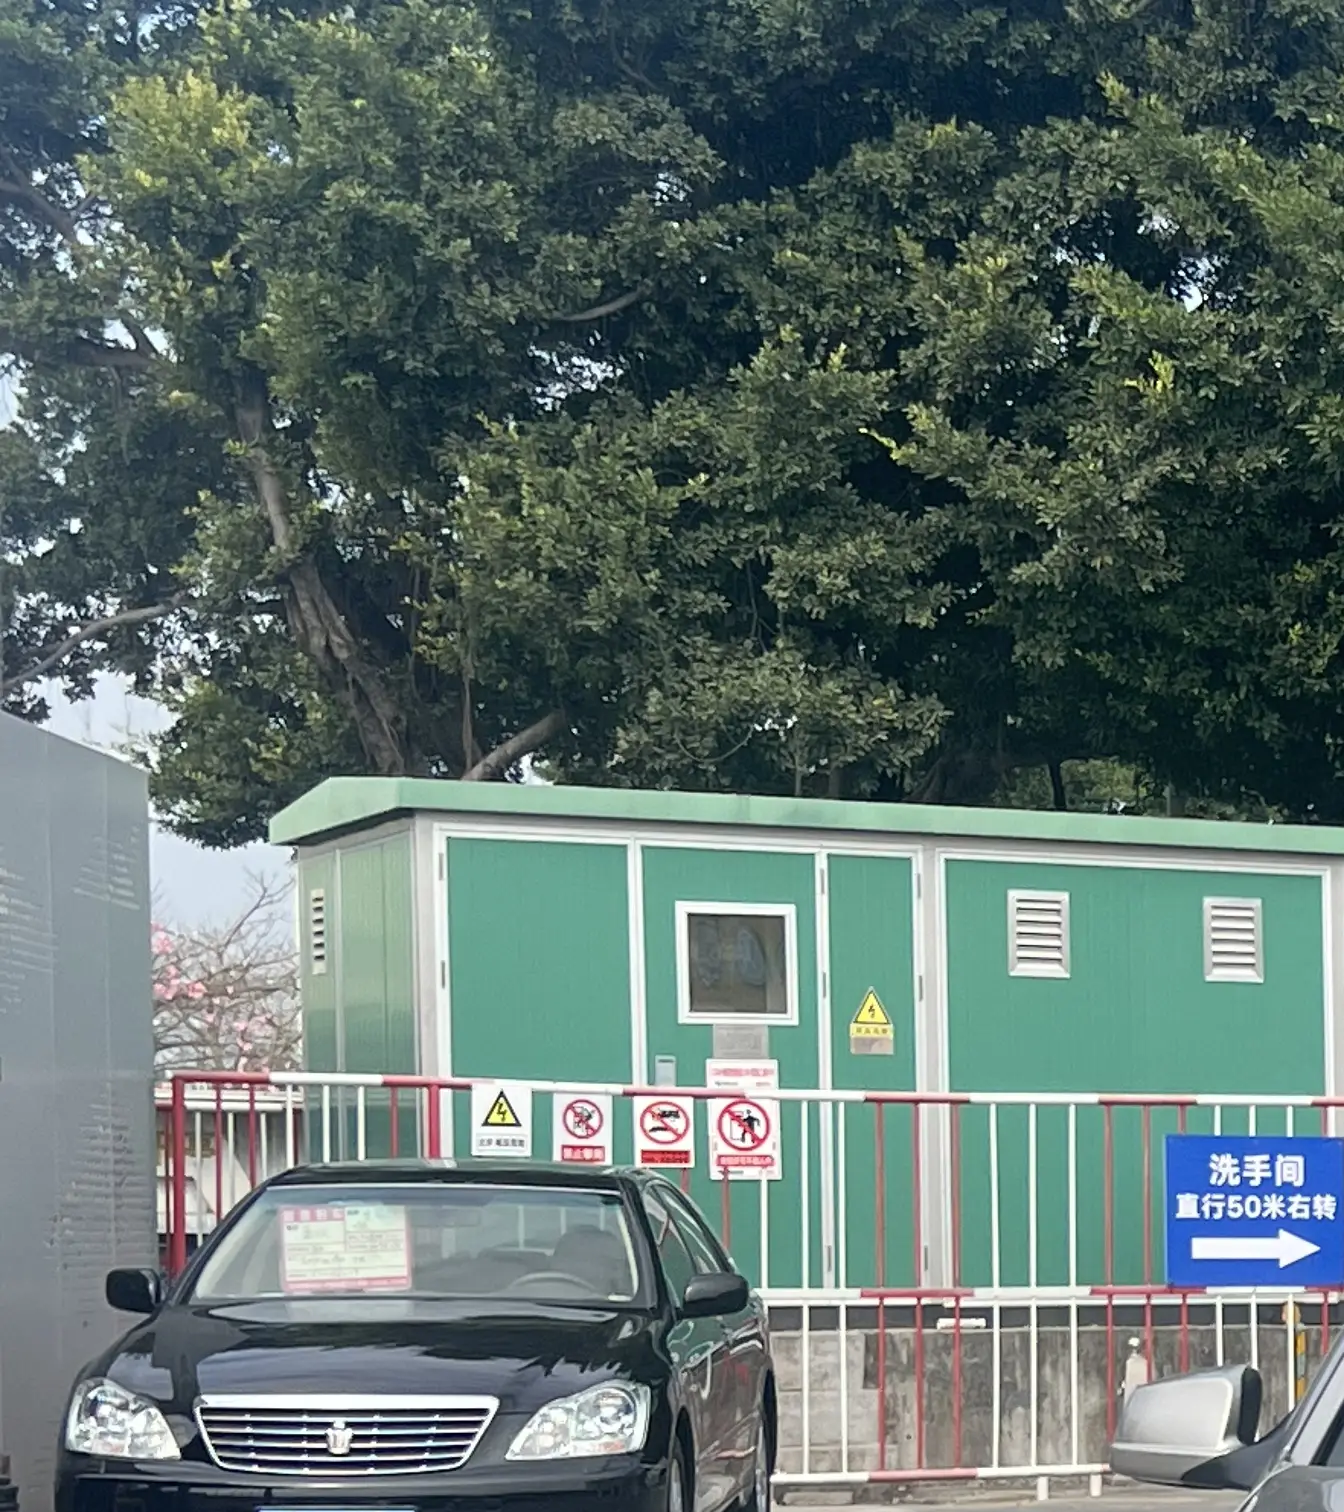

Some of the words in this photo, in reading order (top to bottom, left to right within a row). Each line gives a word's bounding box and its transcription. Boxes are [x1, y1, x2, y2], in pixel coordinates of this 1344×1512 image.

[1208, 1153, 1306, 1187] 洗手间
[1175, 1193, 1338, 1221] 直行50米右转
